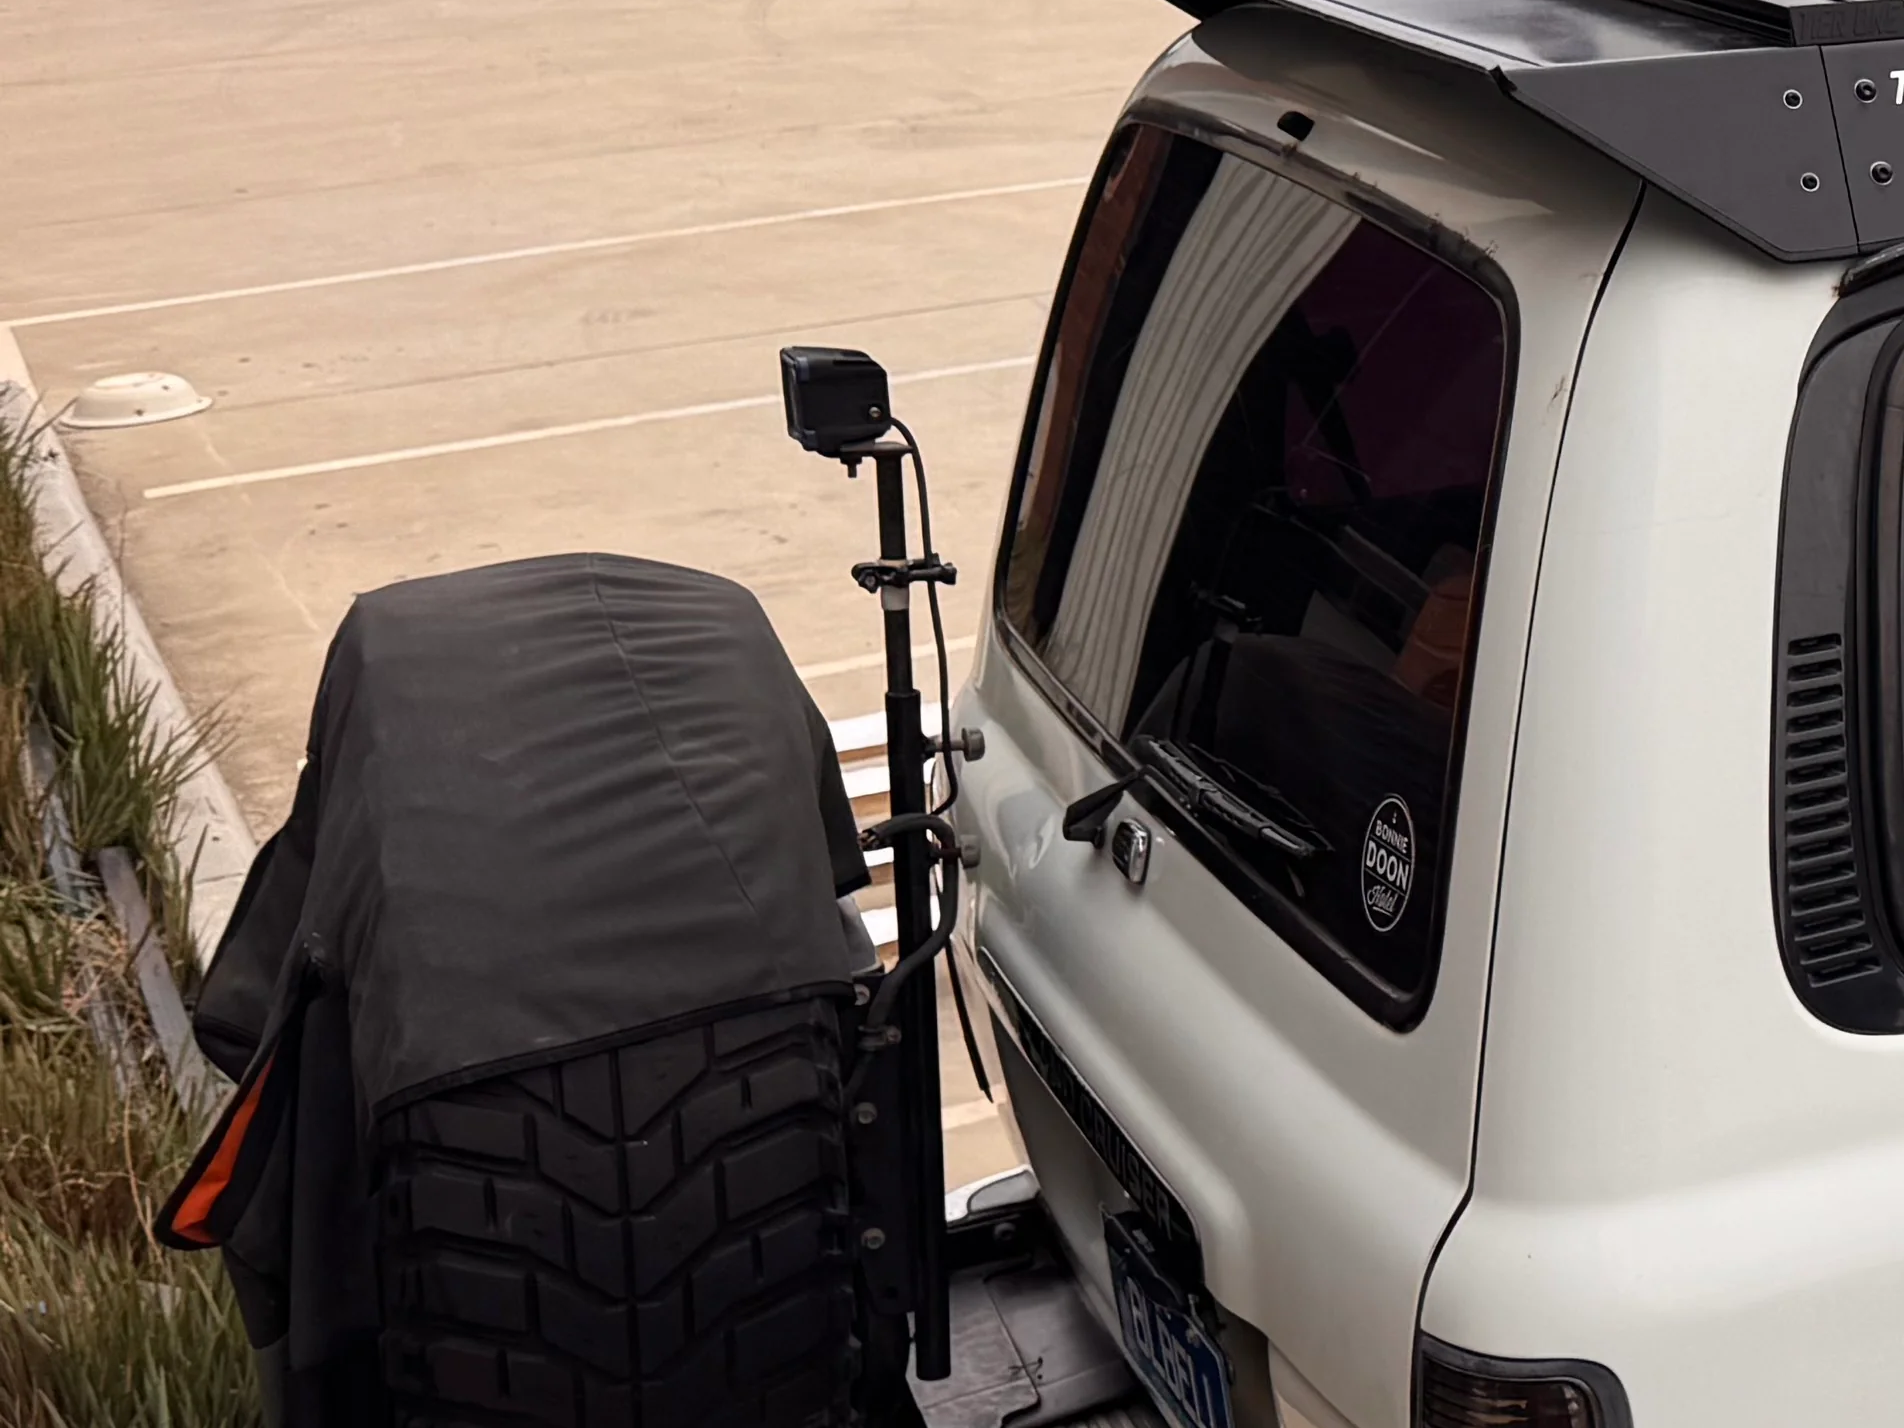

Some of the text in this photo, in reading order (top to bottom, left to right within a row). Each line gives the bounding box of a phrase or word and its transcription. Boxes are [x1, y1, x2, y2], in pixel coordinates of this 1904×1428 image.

[1375, 819, 1409, 854] BONNIE
[1365, 840, 1410, 892] DOON
[1366, 885, 1399, 913] Hotel
